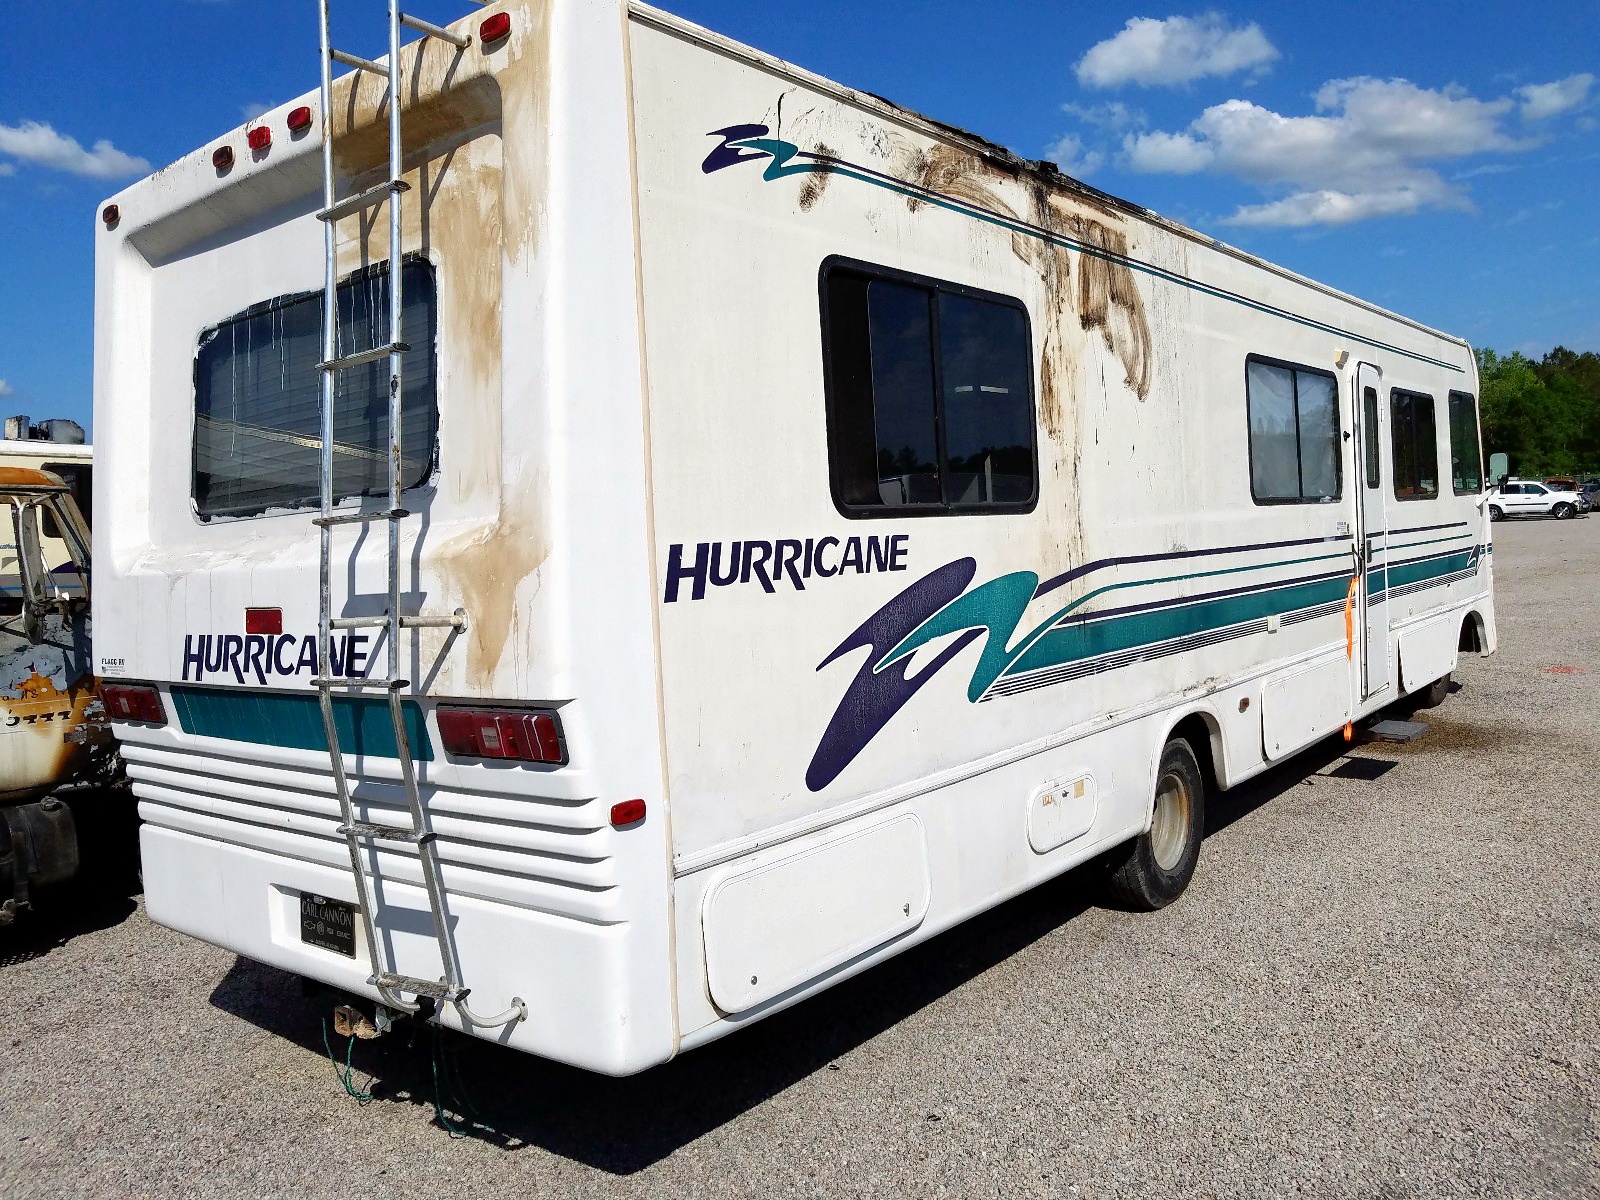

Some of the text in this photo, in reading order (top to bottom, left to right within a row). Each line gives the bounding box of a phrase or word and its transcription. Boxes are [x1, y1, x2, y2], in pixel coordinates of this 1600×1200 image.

[664, 534, 909, 604] HURRICANE
[101, 658, 117, 666] FLAGG
[182, 634, 369, 685] HURRICANE
[302, 900, 352, 927] CARL CANNON
[336, 930, 351, 940] GMC
